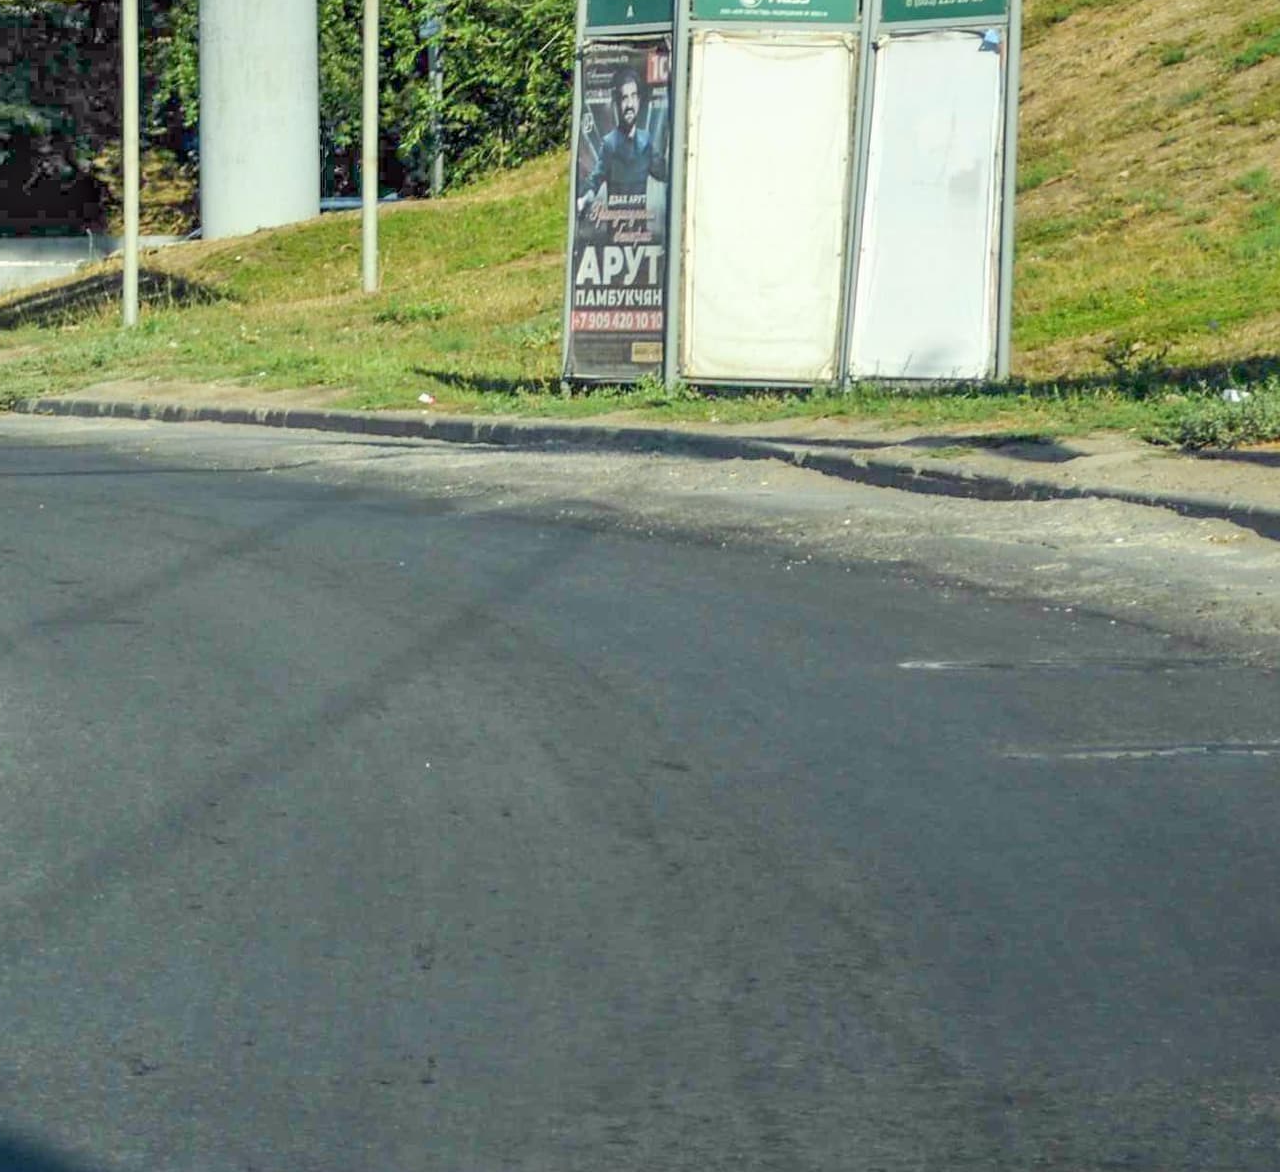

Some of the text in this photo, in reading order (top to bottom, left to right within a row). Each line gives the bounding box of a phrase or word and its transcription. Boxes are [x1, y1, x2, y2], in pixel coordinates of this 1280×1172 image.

[575, 246, 663, 285] АРУТ
[575, 288, 662, 307] ПАМБУКЧЯН
[612, 312, 633, 328] 420
[636, 311, 648, 328] 10
